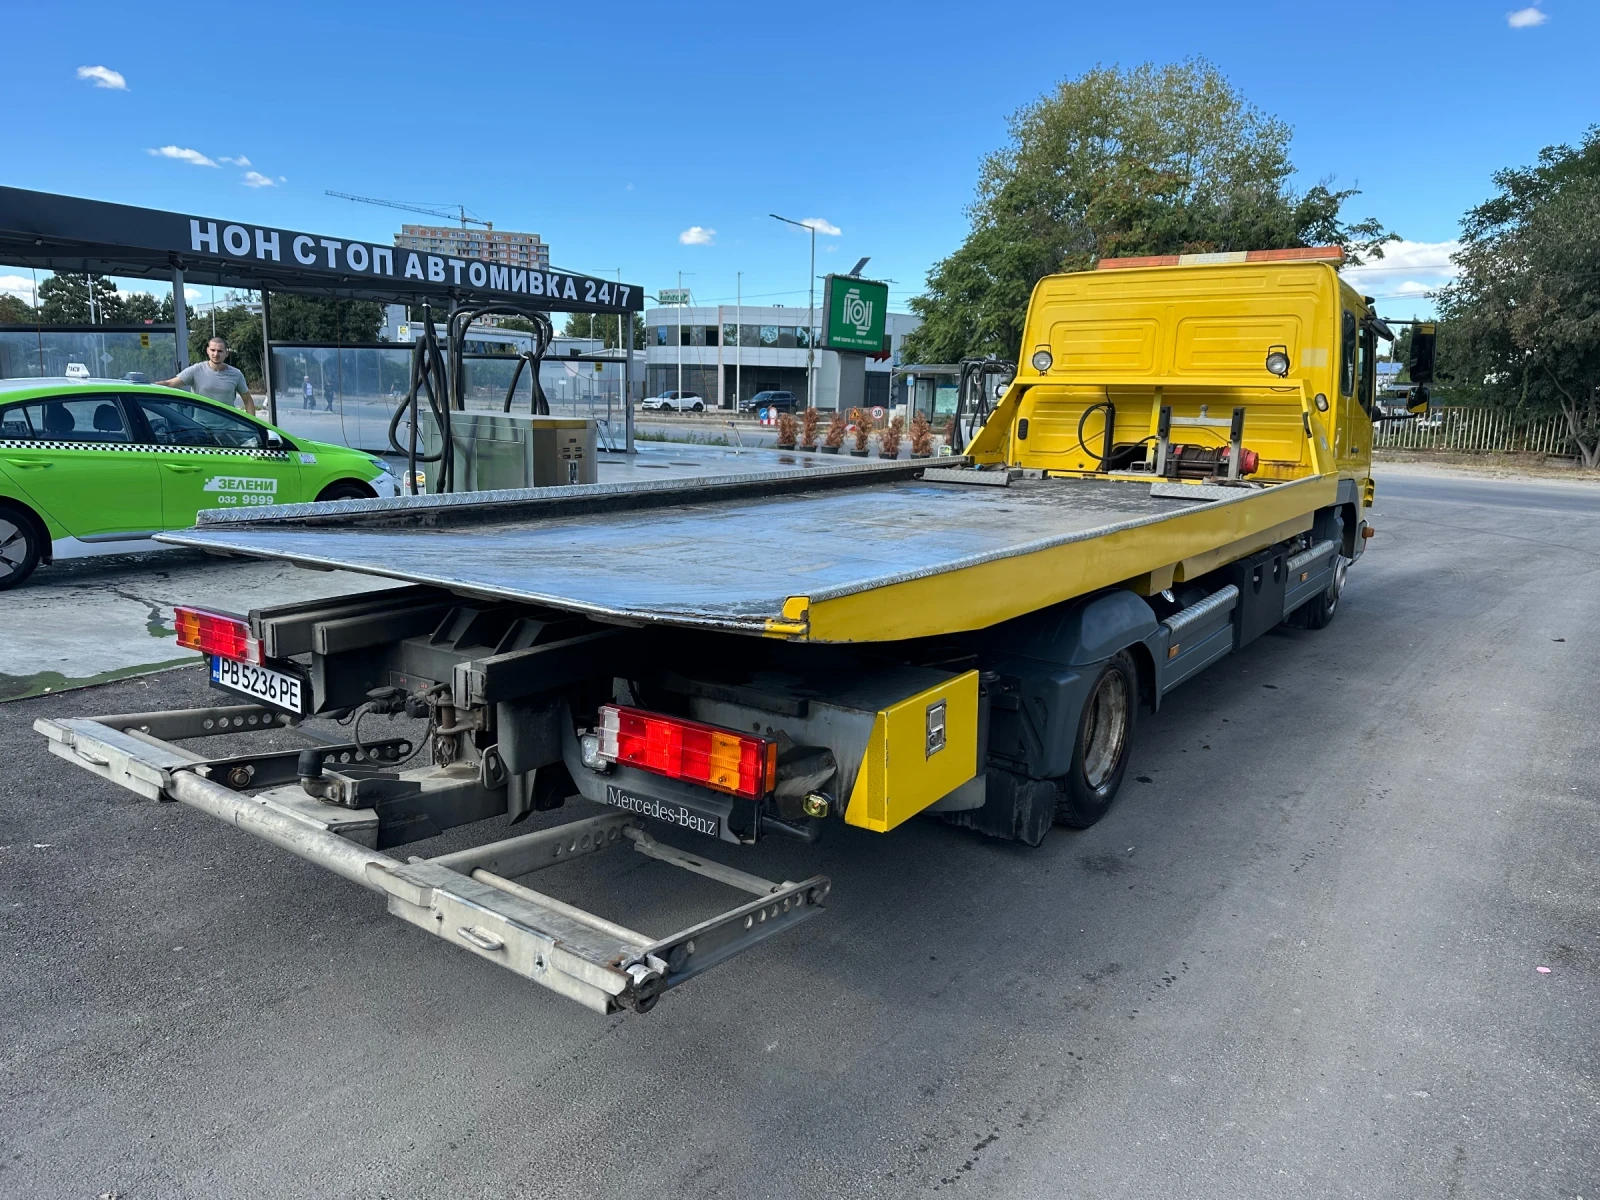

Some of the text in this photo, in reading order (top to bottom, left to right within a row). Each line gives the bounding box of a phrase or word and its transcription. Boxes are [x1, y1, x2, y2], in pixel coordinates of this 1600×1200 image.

[189, 219, 631, 307] НОН СТОП АВТОМИВКА 24/7
[874, 409, 882, 417] 30
[218, 478, 274, 491] ЗЕЛЕНИ
[217, 494, 274, 505] 032 9999
[242, 665, 277, 699] 5236
[280, 678, 299, 708] PE
[608, 788, 717, 836] Mercedes-Benz
